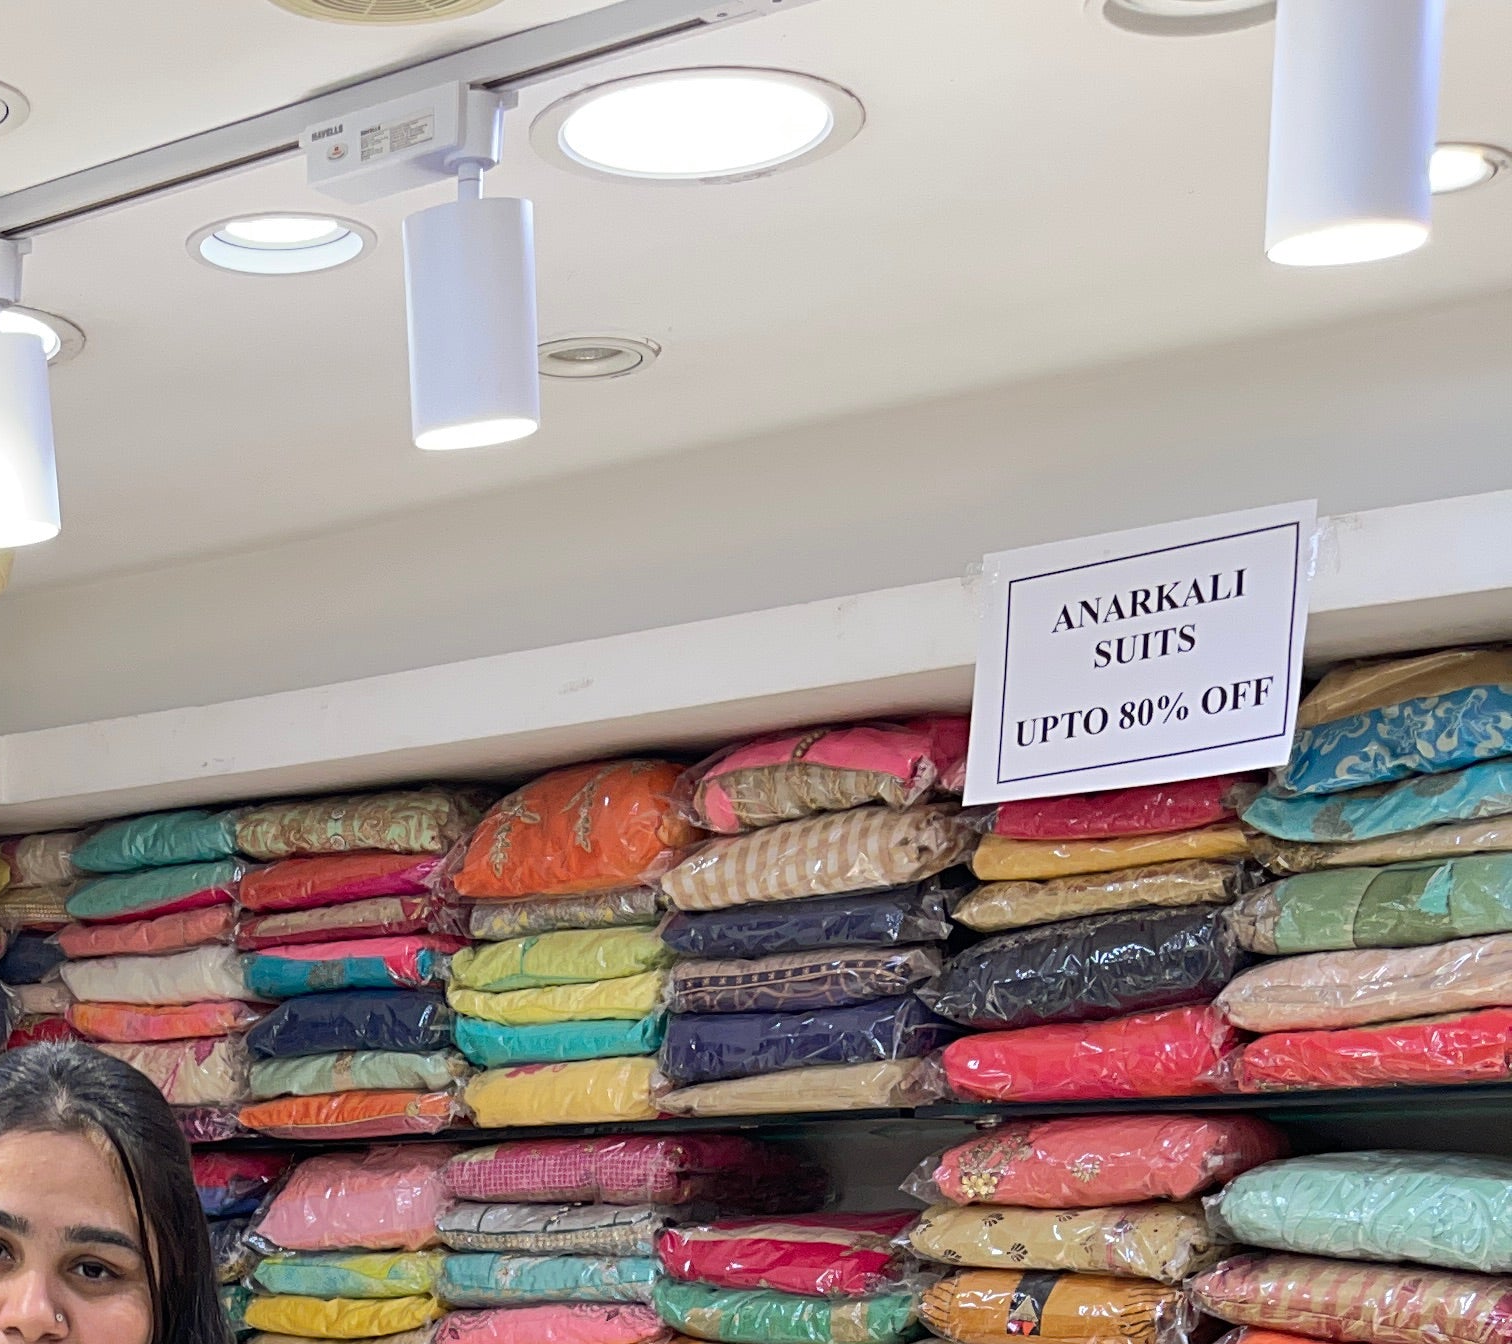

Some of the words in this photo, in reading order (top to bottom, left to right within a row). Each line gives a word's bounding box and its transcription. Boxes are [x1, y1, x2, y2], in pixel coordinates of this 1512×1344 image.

[1051, 568, 1248, 633] ANARKALI
[1093, 623, 1197, 669] SUITS
[1016, 706, 1109, 747] UPTO
[1119, 692, 1189, 729] 80%
[1201, 676, 1274, 716] OFF
